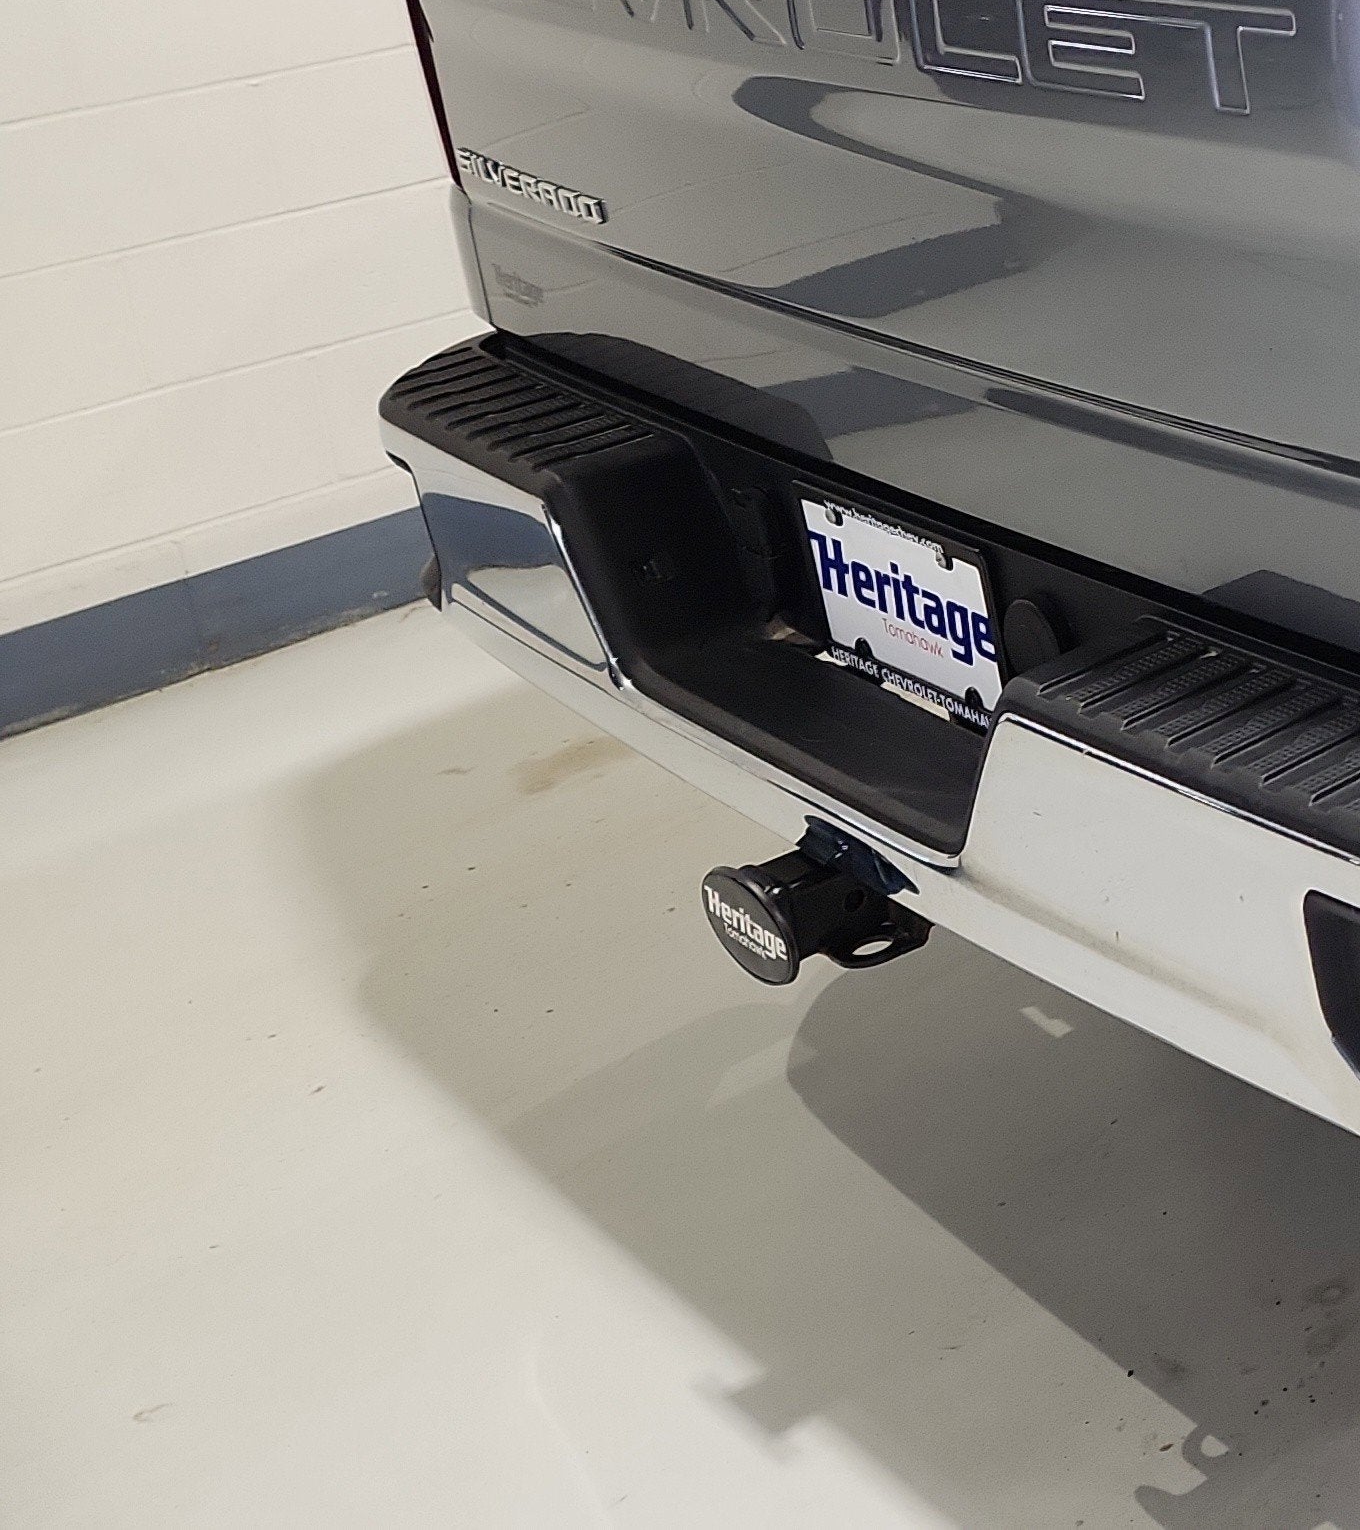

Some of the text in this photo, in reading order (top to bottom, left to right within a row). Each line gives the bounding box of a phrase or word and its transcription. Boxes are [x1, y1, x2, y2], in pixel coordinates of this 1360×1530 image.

[456, 147, 608, 224] SILVERADO
[807, 530, 998, 666] Heritage
[831, 646, 880, 679] HERITAGE
[882, 617, 944, 659] Tomahawk
[704, 885, 788, 961] Heritage
